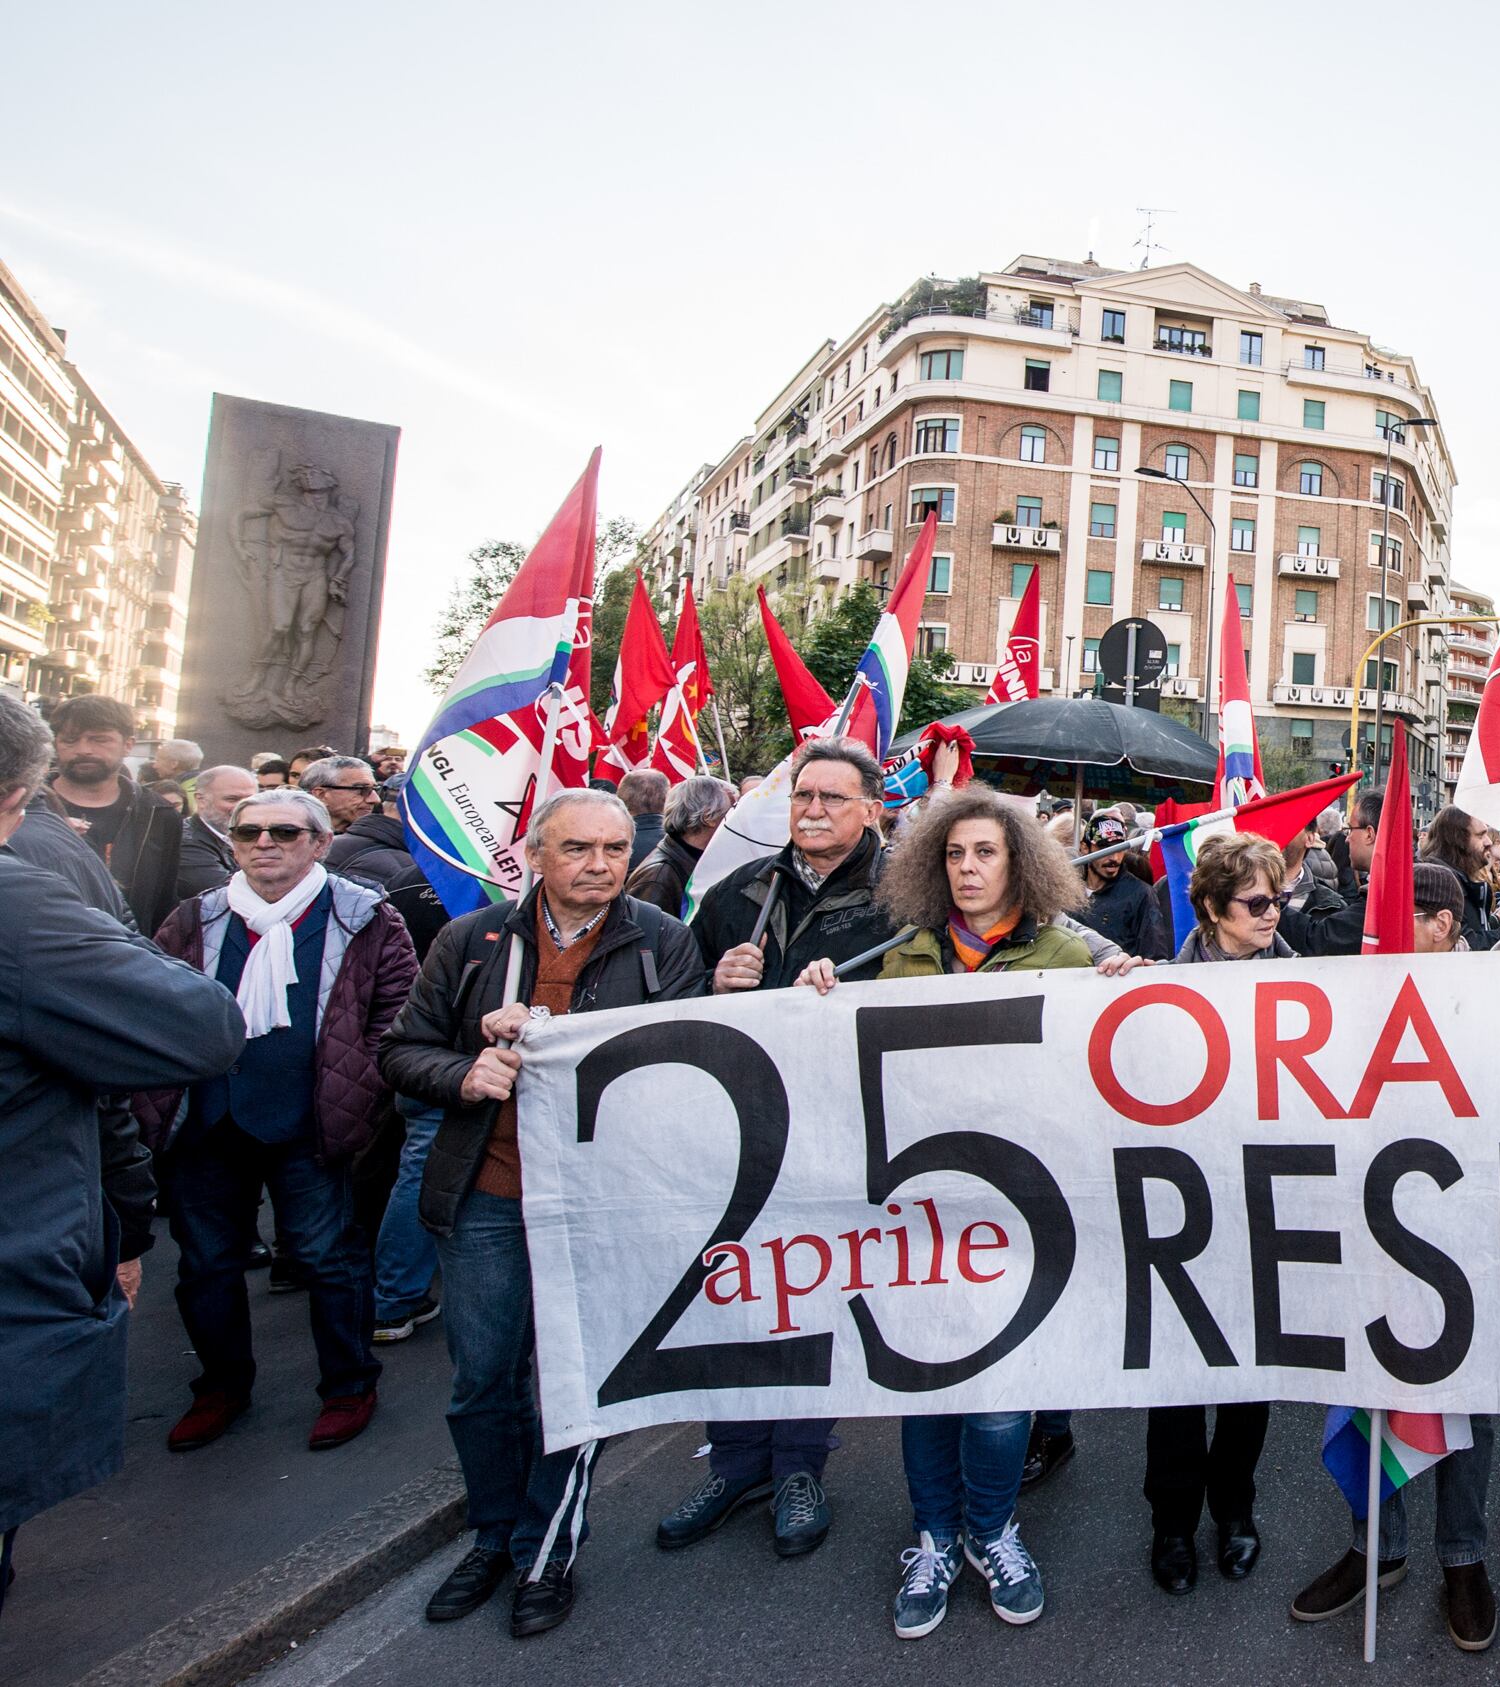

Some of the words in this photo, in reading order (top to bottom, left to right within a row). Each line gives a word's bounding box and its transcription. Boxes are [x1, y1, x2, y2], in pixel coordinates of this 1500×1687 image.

[1089, 973, 1479, 1126] ORA
[576, 995, 1076, 1408] 25
[704, 1197, 1010, 1333] aprile
